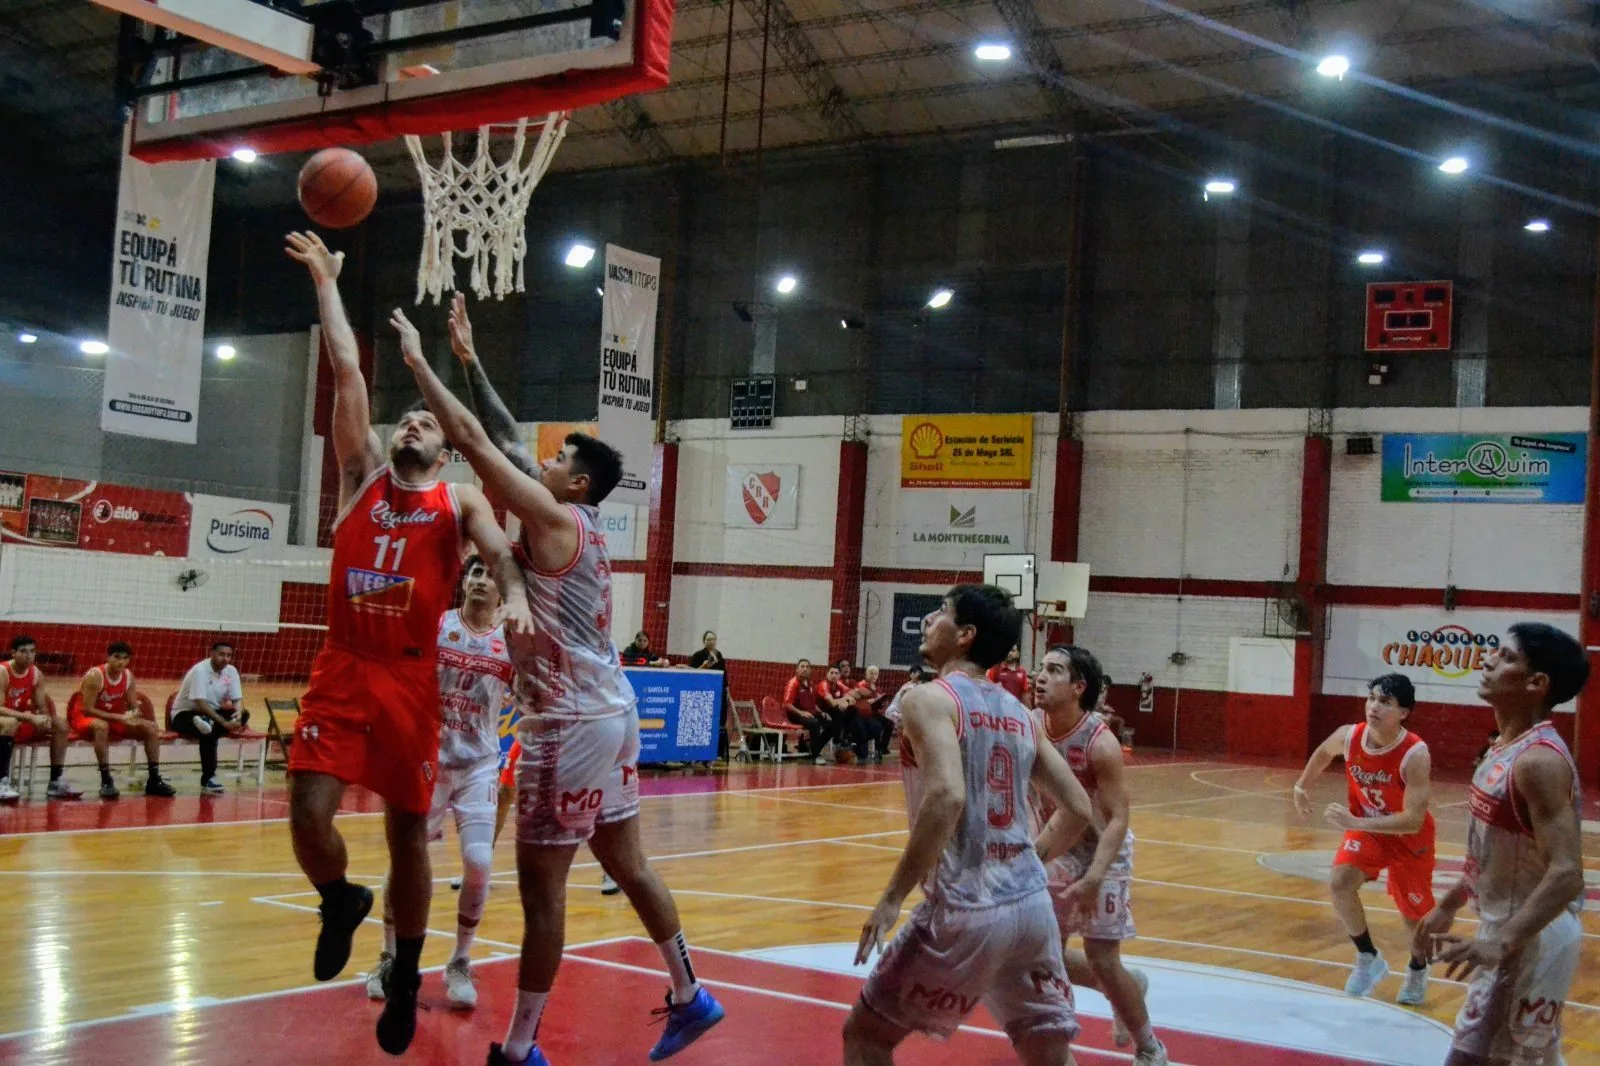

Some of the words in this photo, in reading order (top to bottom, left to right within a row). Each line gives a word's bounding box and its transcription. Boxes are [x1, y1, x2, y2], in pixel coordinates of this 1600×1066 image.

[120, 230, 177, 268] EQUIPÁ
[144, 267, 201, 303] RUTINA
[156, 300, 167, 316] TU
[169, 307, 200, 322] JUEGO
[603, 347, 637, 373] EQUIPÁ
[619, 375, 651, 398] RUTINA
[625, 400, 633, 410] TU
[632, 400, 650, 413] JUEGO
[979, 436, 989, 444] de
[976, 448, 998, 459] Mayo
[1403, 442, 1550, 478] InterQuim
[210, 518, 270, 541] Purísima
[912, 533, 927, 542] LA
[928, 533, 1010, 545] MONTENEGRINA
[374, 534, 407, 571] 11
[1407, 630, 1499, 647] LOTERIA
[1382, 642, 1499, 671] CHAQUE
[986, 742, 1016, 830] 9
[1104, 892, 1115, 914] 6
